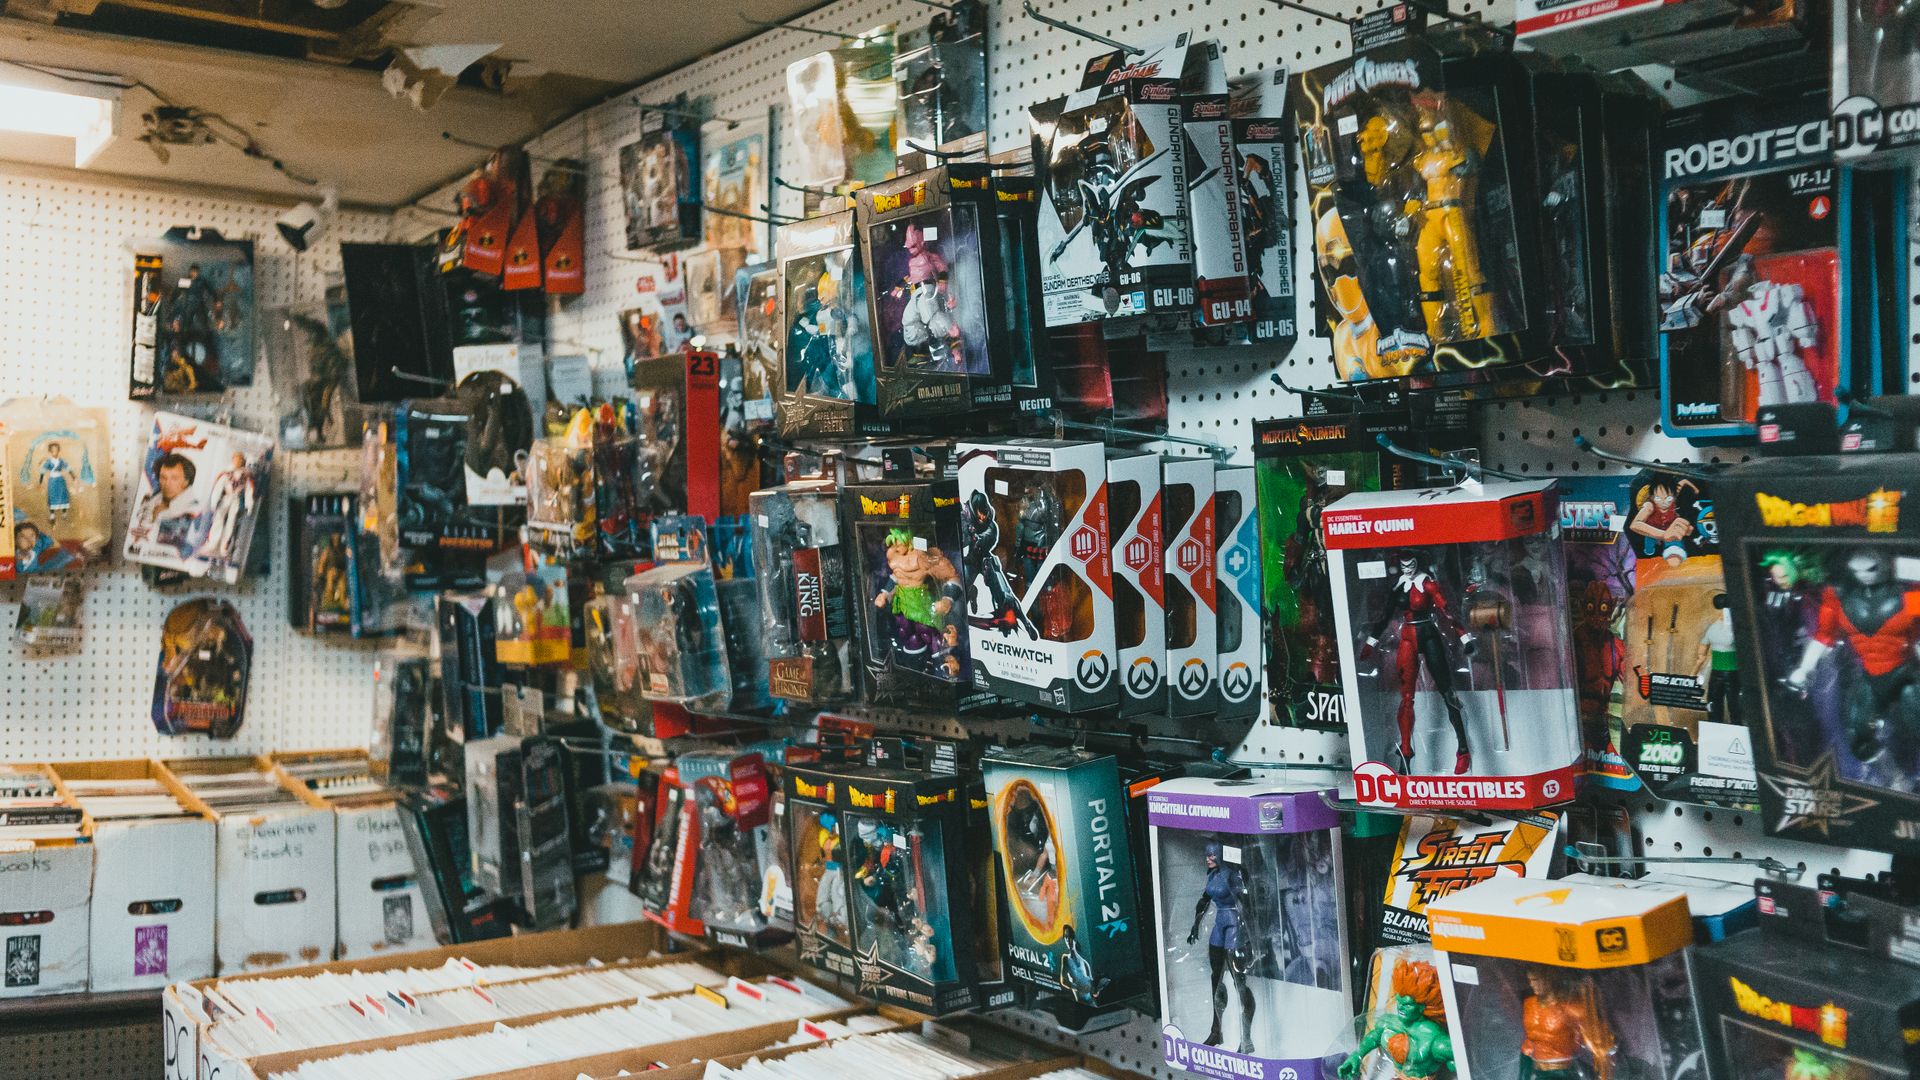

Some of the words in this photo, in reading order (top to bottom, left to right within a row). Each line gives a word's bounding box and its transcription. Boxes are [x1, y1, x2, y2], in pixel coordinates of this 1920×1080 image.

[1168, 108, 1182, 162] GUNDAM
[1833, 108, 1882, 151] DC
[1218, 124, 1234, 186] GUNDAM
[1665, 119, 1835, 179] ROBOTECH
[1789, 169, 1831, 190] VF-1J
[1172, 167, 1189, 261] DEATHSCYTHE
[1225, 191, 1244, 273] BARBATOS
[1120, 272, 1141, 285] GU-06
[1278, 248, 1290, 295] BANSHEE
[1153, 287, 1194, 307] GU-06
[1212, 299, 1252, 320] GU-04
[1256, 319, 1293, 338] GU-05
[691, 356, 714, 376] 23
[1020, 397, 1052, 411] VEGITO
[1262, 430, 1298, 444] MORTAL
[1307, 425, 1346, 441] KOMBAT
[861, 495, 886, 515] DRAGON
[1560, 502, 1617, 529] STERS
[1329, 521, 1372, 535] HARLEY
[1374, 518, 1414, 534] QUINN
[797, 573, 813, 617] KING
[811, 576, 821, 612] NIGHT
[981, 640, 1054, 665] OVERWATCH
[776, 662, 799, 679] GAME
[775, 679, 808, 697] THRONES
[1640, 743, 1683, 764] ZORO
[1354, 774, 1399, 802] DC
[1406, 780, 1526, 799] COLLECTIBLES
[1545, 784, 1556, 794] 13
[1727, 779, 1758, 791] D'ACTIO
[1149, 802, 1188, 816] KNIGHTFALL
[1189, 804, 1230, 819] CATWOMAN
[1089, 799, 1117, 900] PORTAL
[1409, 832, 1506, 866] STREET
[1102, 902, 1121, 921] 2
[1383, 910, 1430, 934] BLANK
[1008, 943, 1043, 966] PORTAL
[1042, 953, 1050, 968] 2
[1011, 965, 1034, 981] CHELL
[886, 985, 907, 997] FUTURE
[989, 991, 1014, 1006] GOKU
[165, 1009, 189, 1080] DC
[1163, 1034, 1189, 1066] DC
[1191, 1047, 1264, 1080] COLLECTIBLES
[1282, 1071, 1295, 1080] 22
